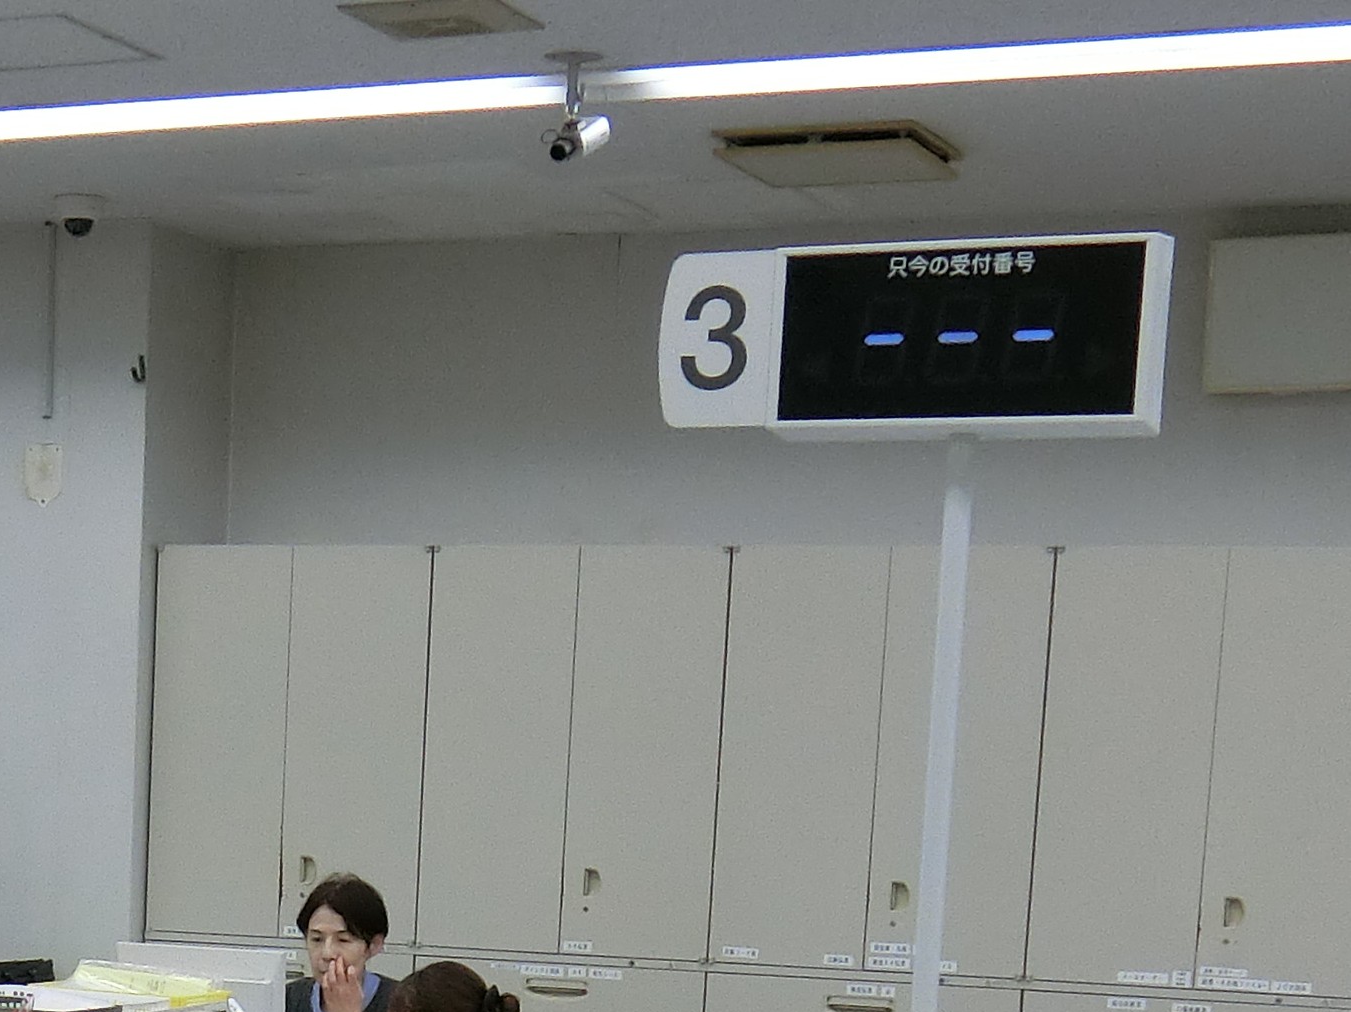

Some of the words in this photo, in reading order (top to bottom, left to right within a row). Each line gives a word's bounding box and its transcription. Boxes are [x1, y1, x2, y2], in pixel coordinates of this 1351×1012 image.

[887, 251, 1037, 278] 只今の受付番号
[680, 285, 748, 391] 3
